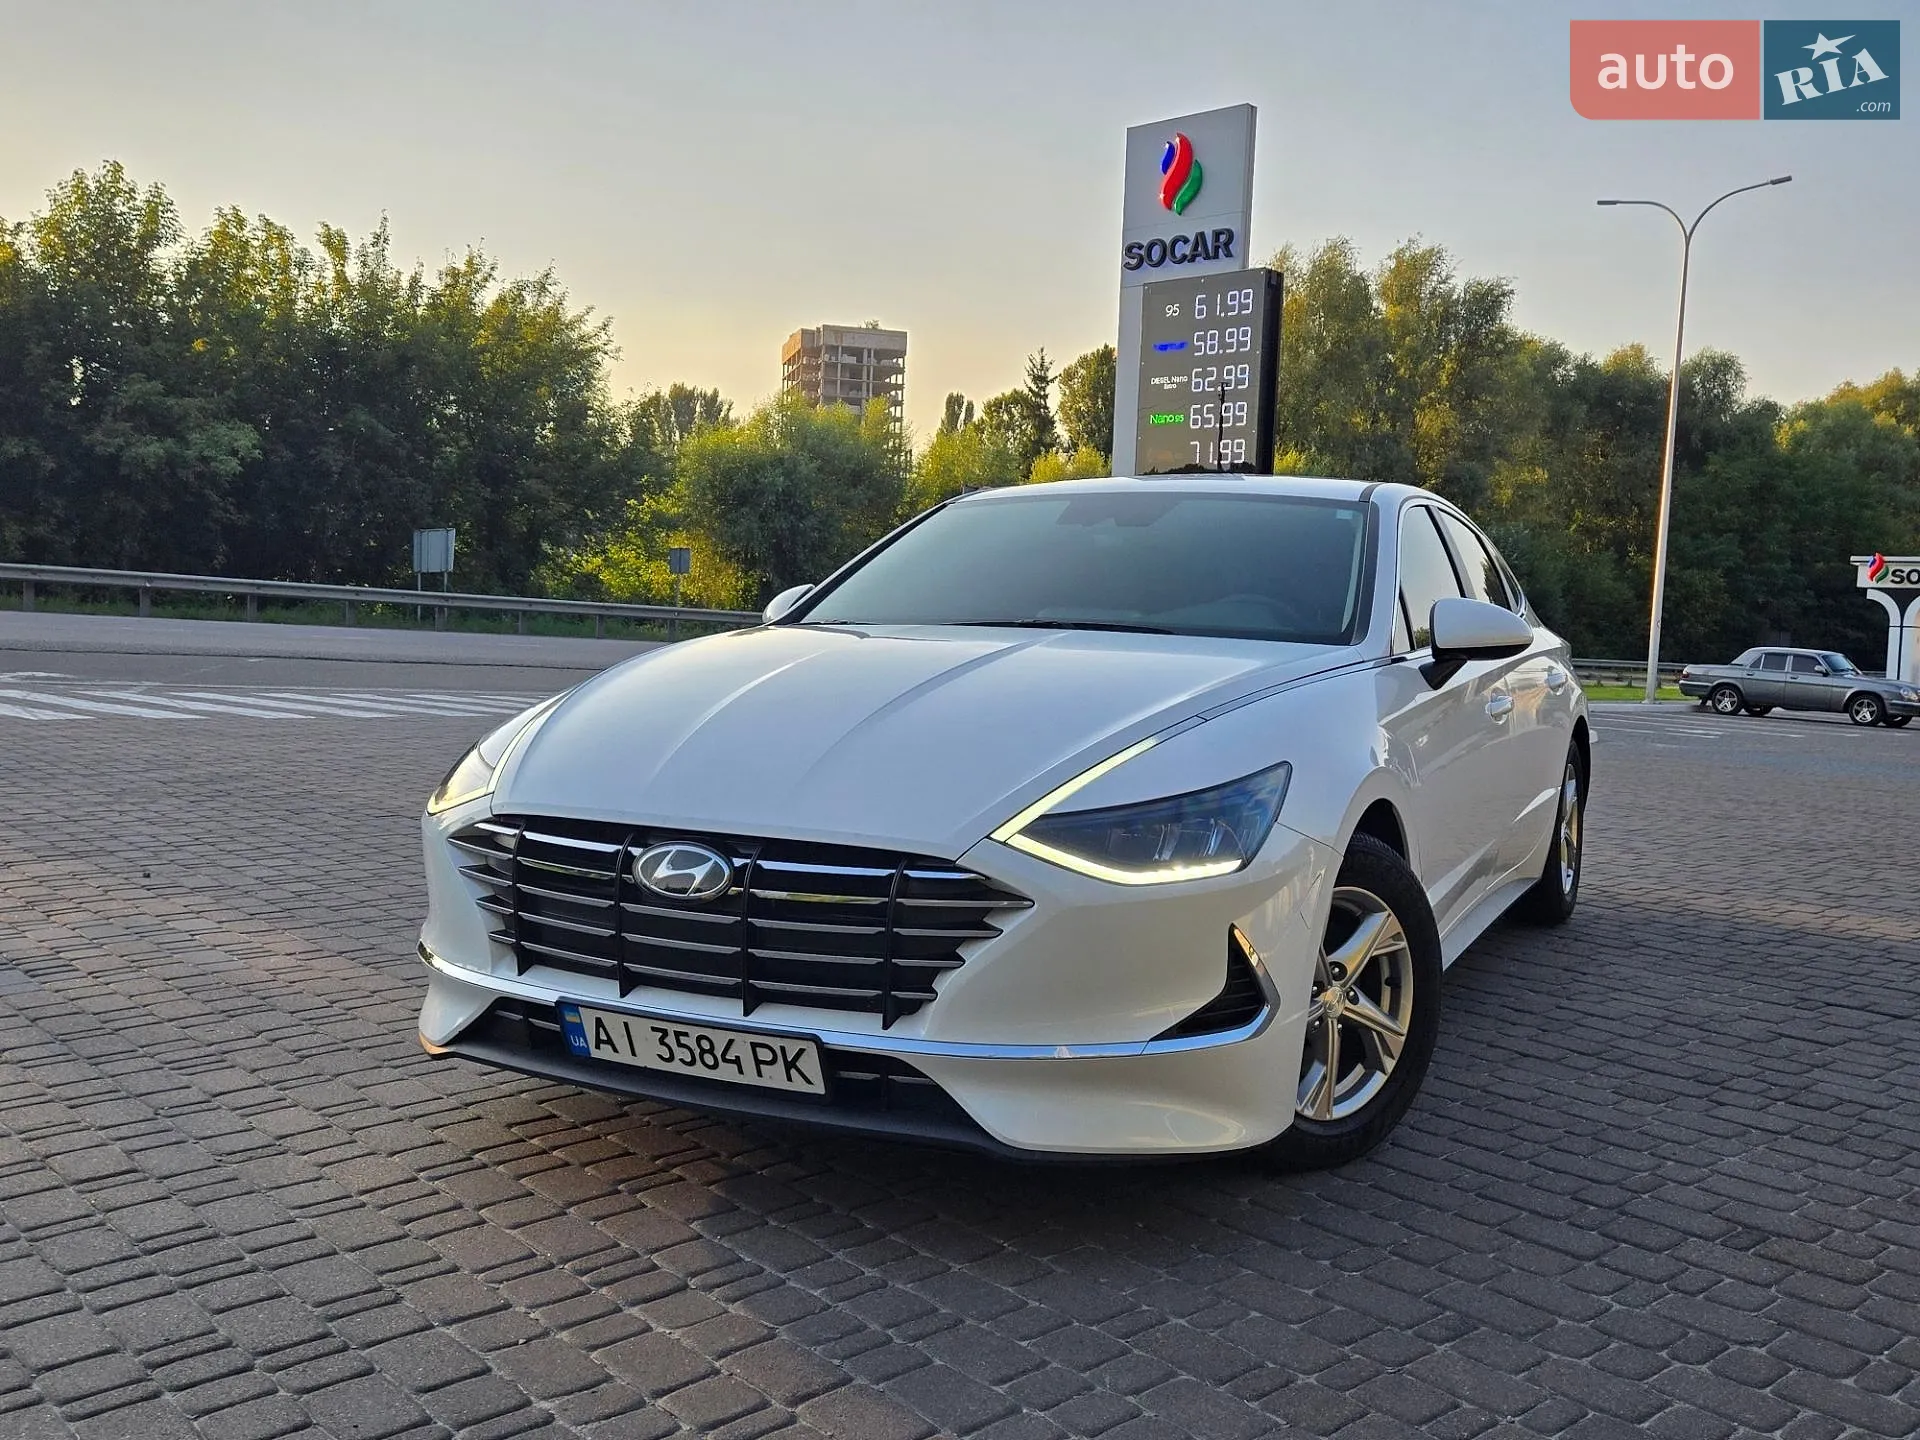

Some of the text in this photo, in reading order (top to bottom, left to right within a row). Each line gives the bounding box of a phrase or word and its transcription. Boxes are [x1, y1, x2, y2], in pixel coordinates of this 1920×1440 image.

[1123, 228, 1235, 271] SOCAR
[1165, 288, 1253, 320] 95 61.99
[1193, 326, 1252, 356] 58.99
[1191, 363, 1250, 392] 62.99
[1190, 402, 1248, 429] 65.99
[1190, 439, 1246, 465] 71.99
[570, 1034, 588, 1049] UA
[594, 1016, 816, 1086] AI 3584 PK
